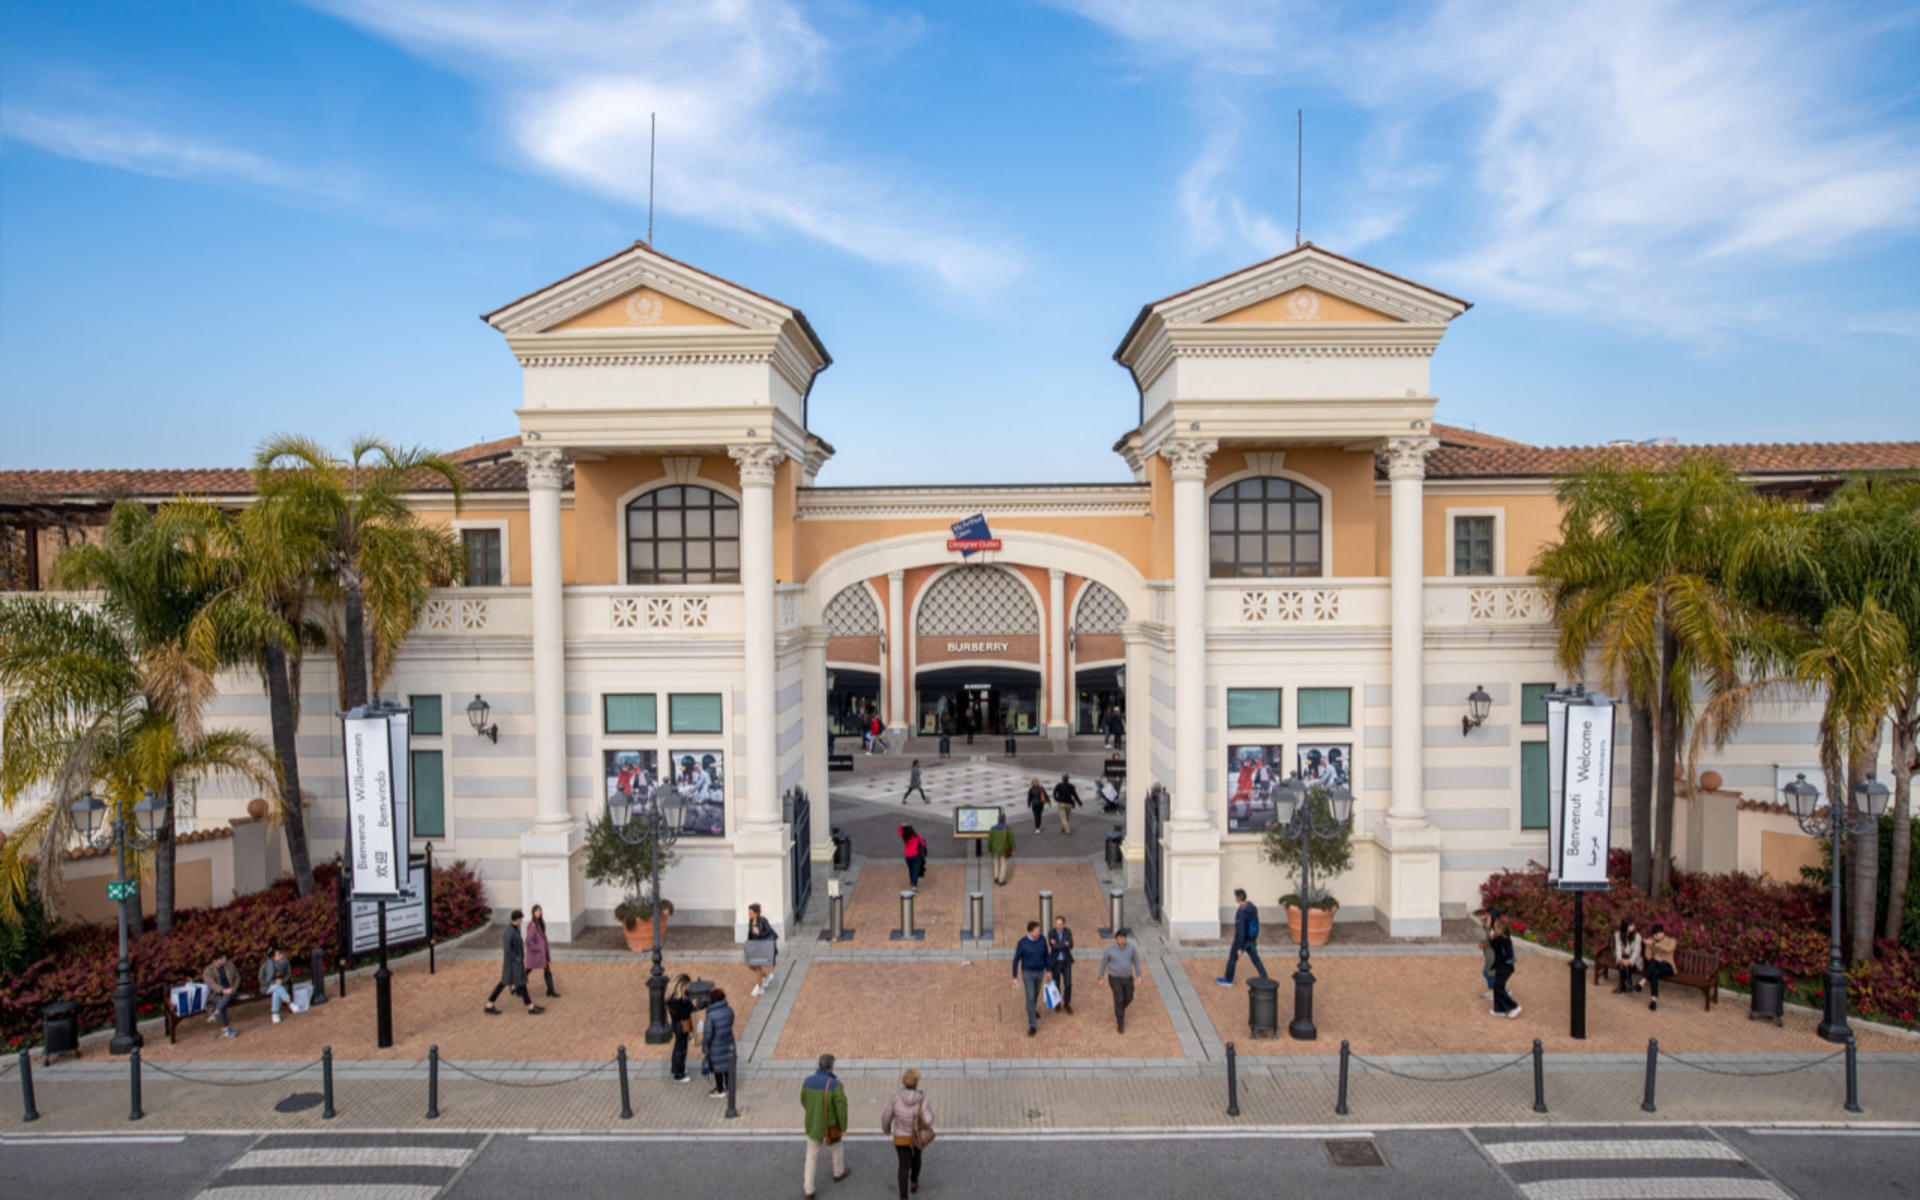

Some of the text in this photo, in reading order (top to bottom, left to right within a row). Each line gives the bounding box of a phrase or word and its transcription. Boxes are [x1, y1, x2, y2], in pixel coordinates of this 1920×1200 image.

[947, 642, 1009, 652] BURBERRY
[354, 733, 368, 870] Bienvenue Willkommen
[375, 770, 389, 827] Bem-vindo
[1566, 720, 1593, 856] Benvenuti Welcome
[374, 851, 388, 878] 欢迎
